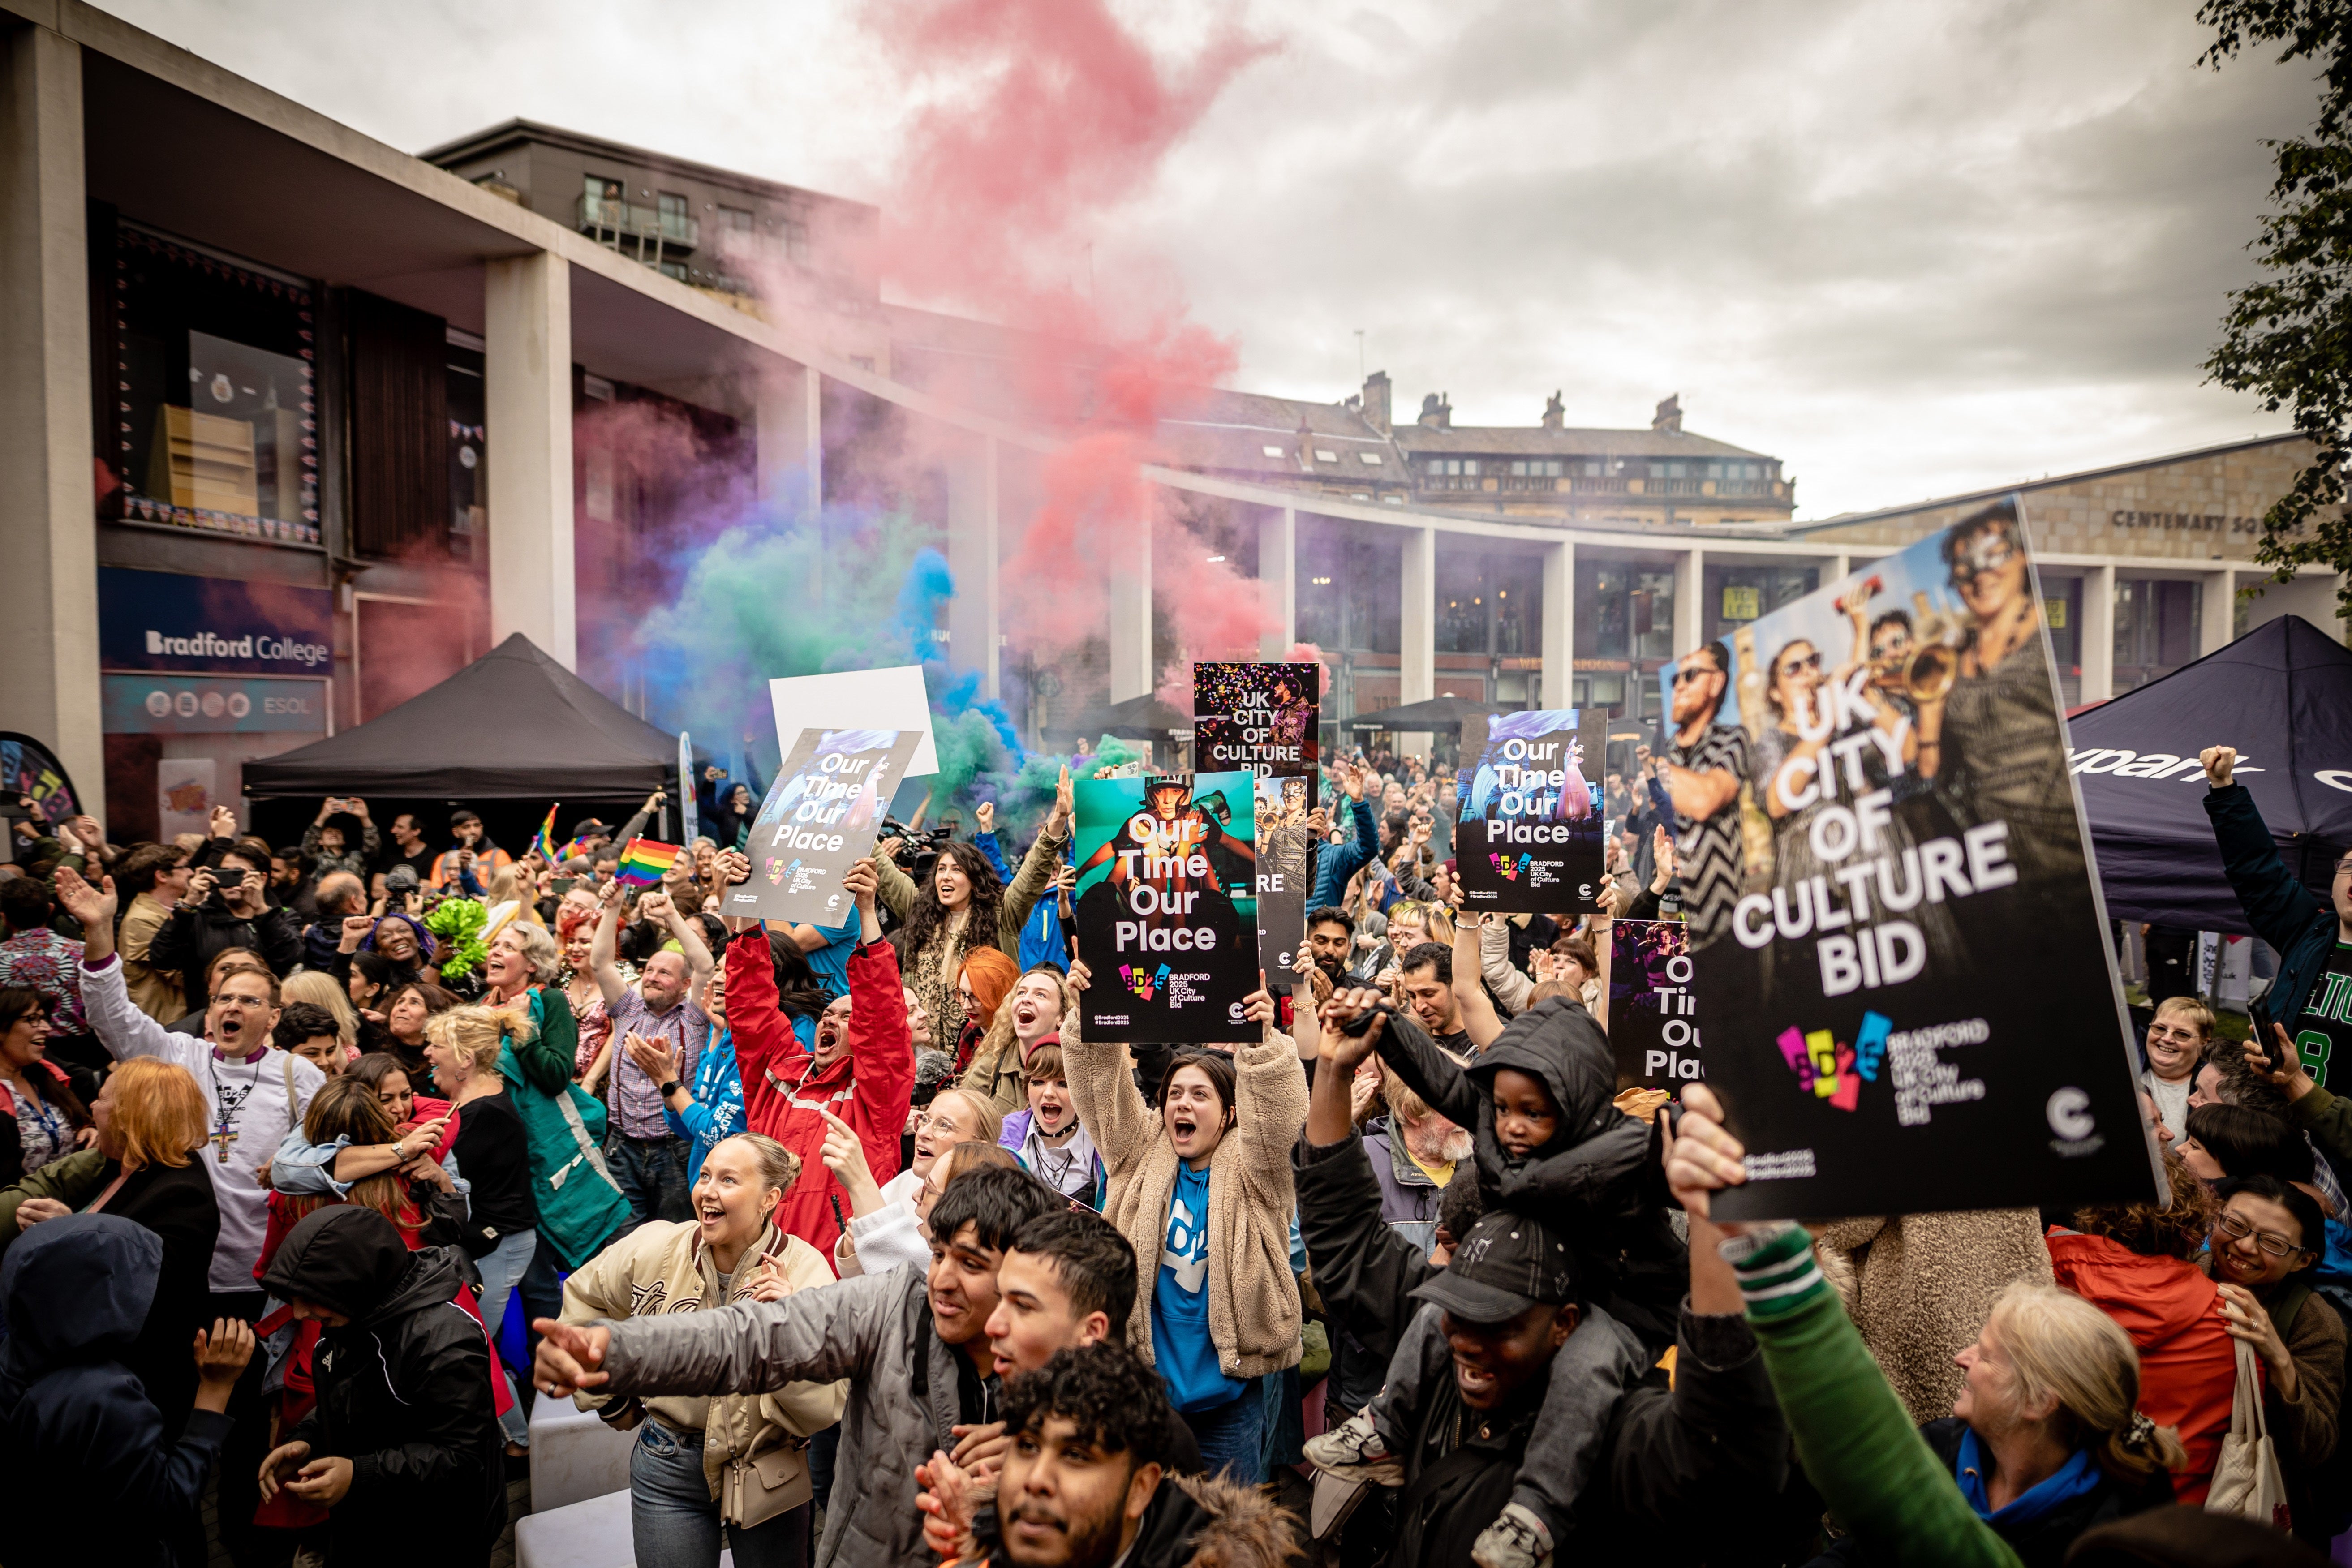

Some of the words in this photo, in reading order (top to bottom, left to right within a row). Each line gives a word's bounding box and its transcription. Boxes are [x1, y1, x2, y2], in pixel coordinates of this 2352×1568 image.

[2112, 510, 2226, 531] CENTENARY
[146, 631, 253, 658] Bradford
[256, 636, 329, 666] College
[263, 697, 310, 715] ESOL
[1243, 692, 1270, 708] UK
[1794, 669, 1880, 743] UK
[1234, 710, 1279, 726] CITY
[1243, 728, 1270, 743] OF
[1213, 745, 1300, 761] CULTURE
[1503, 738, 1559, 761] Our
[821, 752, 870, 774] Our
[1493, 763, 1565, 787] Time
[1776, 716, 1913, 811] CITY
[803, 775, 863, 799] Time
[795, 800, 847, 824] Our
[1500, 791, 1557, 815] Our
[1129, 813, 1197, 843] Our
[1488, 819, 1569, 844] Place
[1809, 788, 1893, 862] OF
[771, 825, 844, 852] Place
[796, 867, 826, 875] BRADFORD
[1118, 847, 1208, 880] Time
[1732, 819, 2017, 949] CULTURE
[1130, 885, 1199, 915] Our
[1116, 920, 1216, 952] Place
[1817, 919, 1927, 997] BID
[1180, 988, 1196, 996] City
[1886, 1017, 1990, 1053] BRADFORD
[1645, 1050, 1702, 1079] Pla
